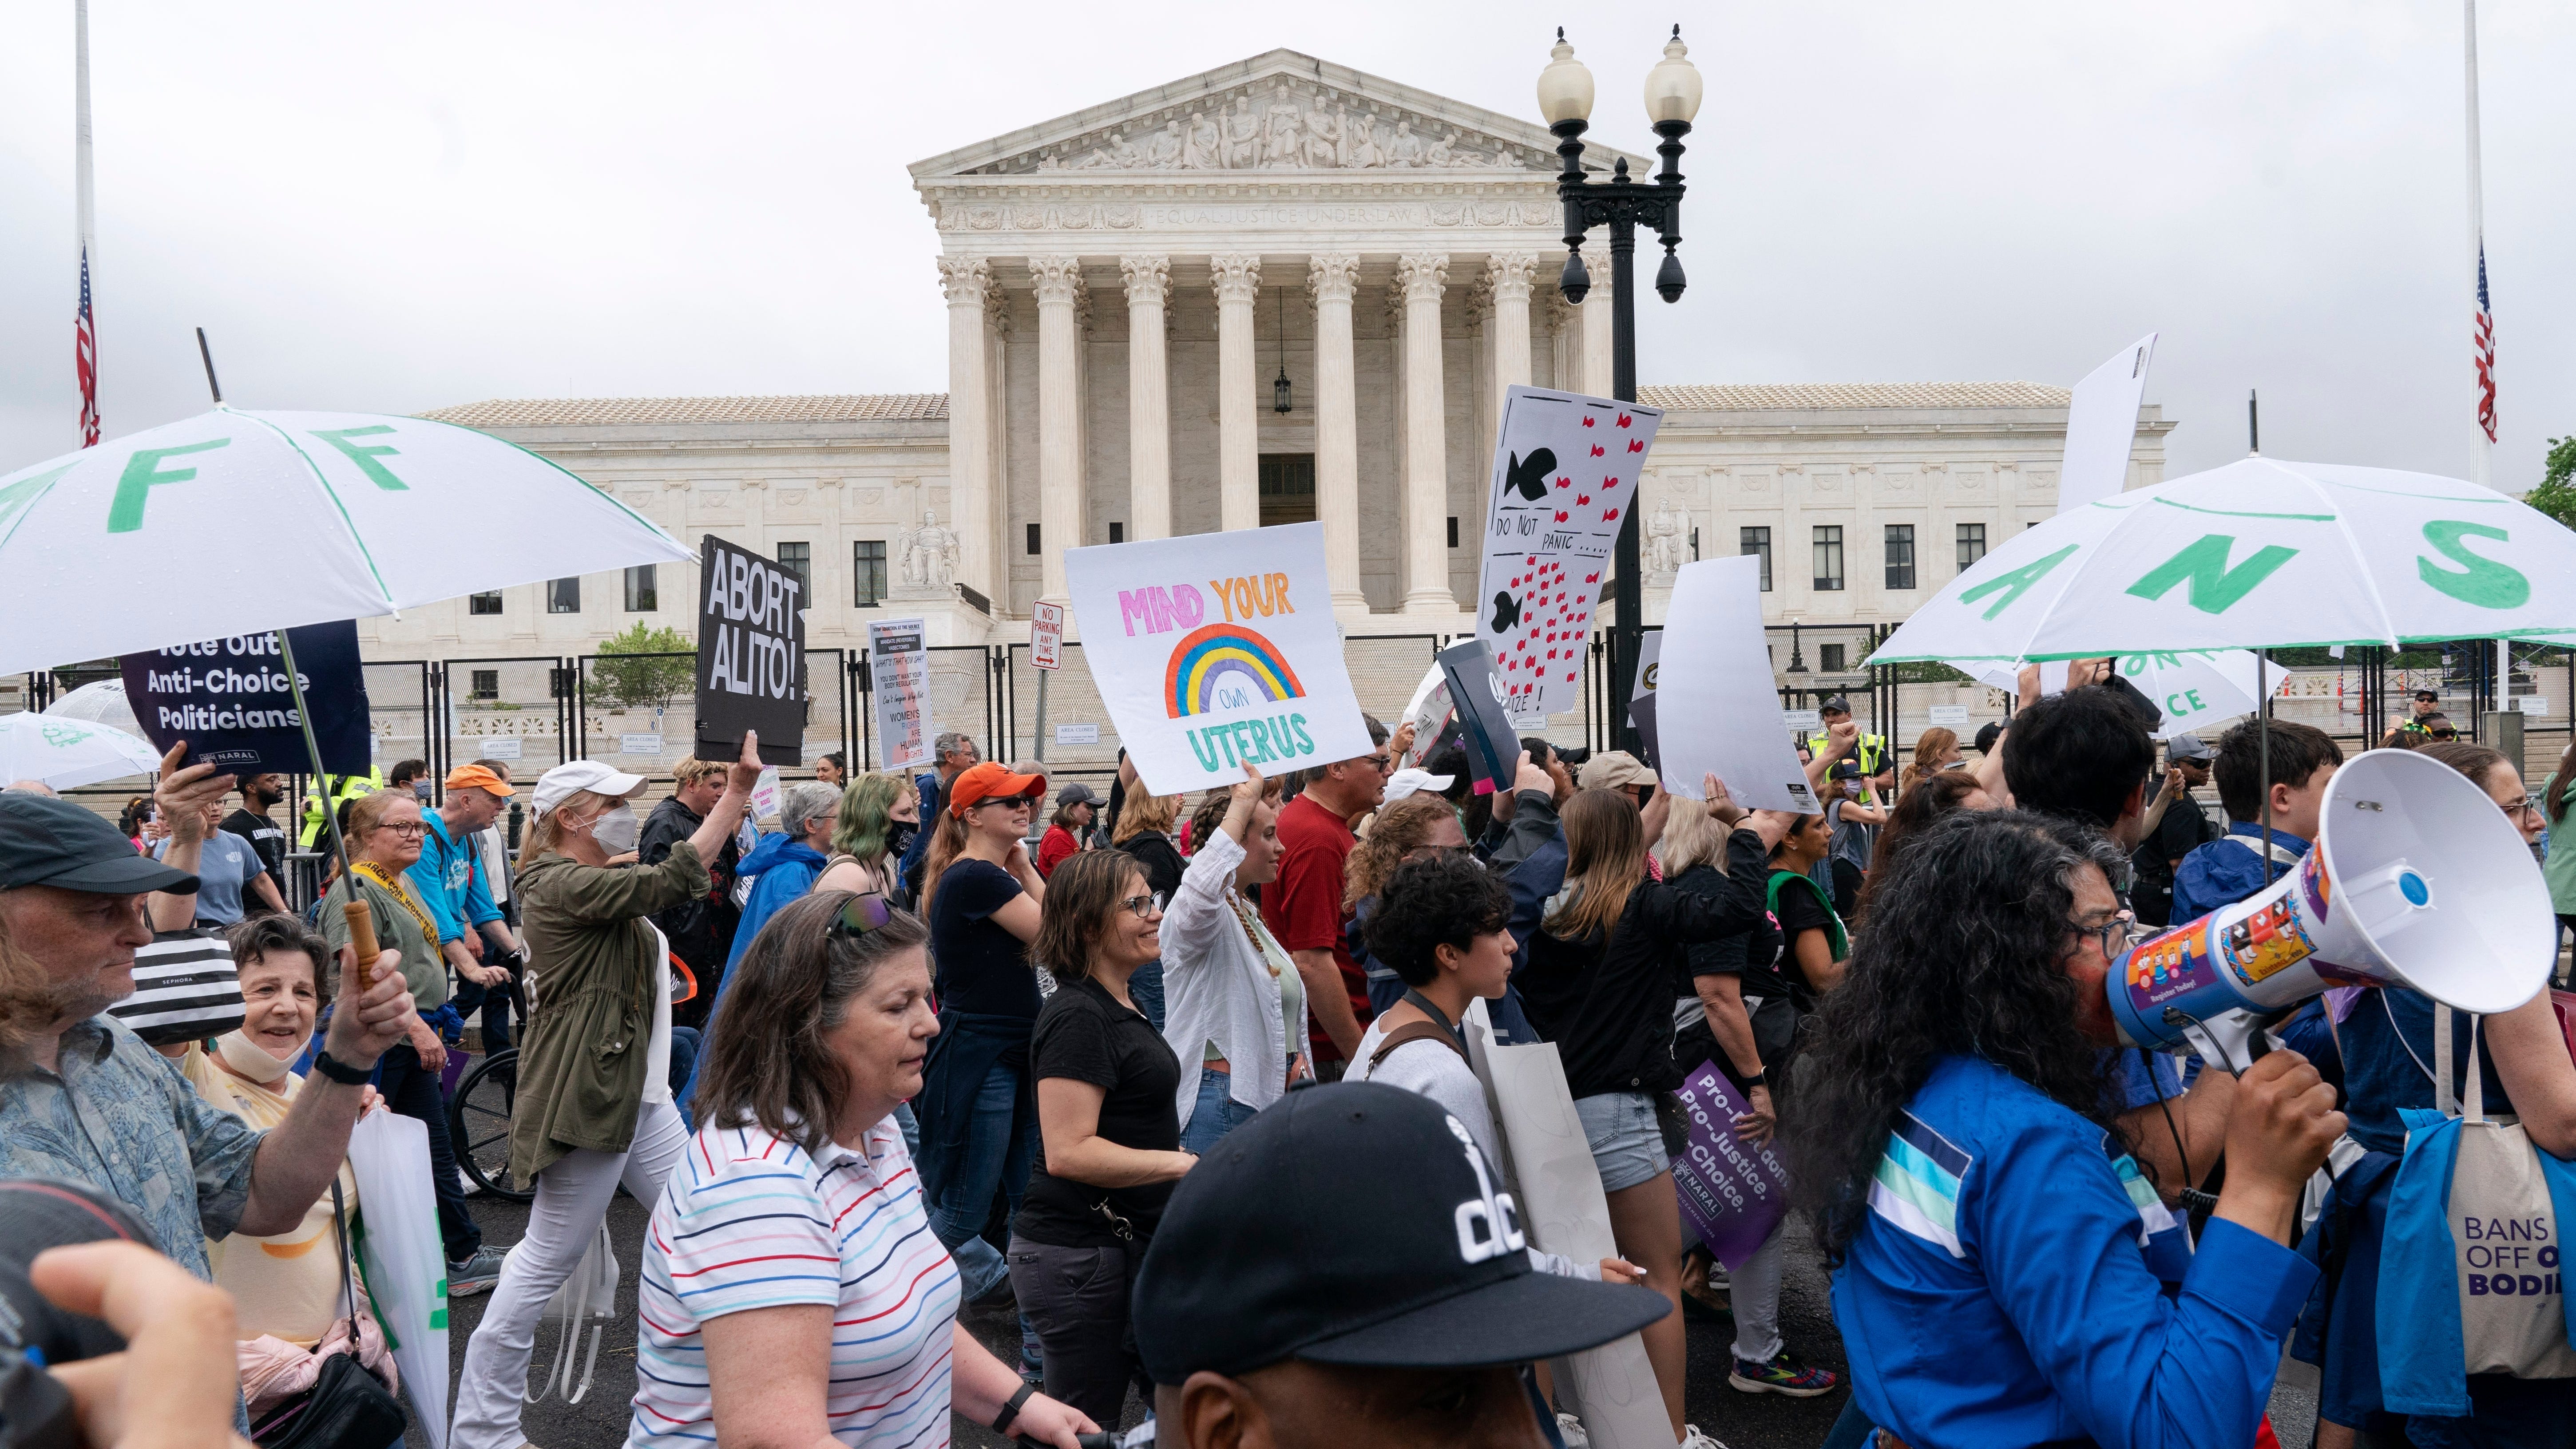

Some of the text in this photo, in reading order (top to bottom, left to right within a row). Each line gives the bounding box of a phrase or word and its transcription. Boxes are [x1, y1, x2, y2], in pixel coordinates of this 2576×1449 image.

[1157, 208, 1411, 225] EQUAL JUSTICE UNDER LAW
[1497, 515, 1538, 536] DO NOT
[708, 548, 799, 640] ABORT
[1118, 572, 1295, 637] MIND YOUR
[1042, 608, 1053, 620] NO
[1034, 620, 1059, 635] PARKING
[227, 631, 282, 655] Out
[1039, 645, 1053, 655] TIME
[1040, 635, 1053, 645] ANY
[709, 623, 796, 700] ALITO!
[876, 658, 892, 668] WHAT'S
[893, 657, 905, 666] THAT
[905, 656, 914, 665] YOU
[148, 666, 310, 693] Anti-Choice
[896, 679, 919, 687] REGULATED?
[1219, 686, 1250, 710] OWN
[159, 704, 304, 730] Politicians
[890, 709, 920, 722] WOMEN'S
[902, 720, 921, 730] RIGHTS
[900, 738, 923, 750] HUMAN
[912, 728, 921, 737] ARE
[1186, 713, 1315, 772] UTERUS
[905, 749, 923, 760] RIGHTS
[388, 880, 403, 898] FOR
[405, 898, 433, 933] WOMEN'S
[2150, 979, 2196, 1002] Register Today!
[1680, 1089, 1767, 1200] Pro-Justice.
[1687, 1176, 1717, 1213] NARAL
[2465, 1217, 2548, 1241] BANS
[2466, 1245, 2529, 1269] OFF
